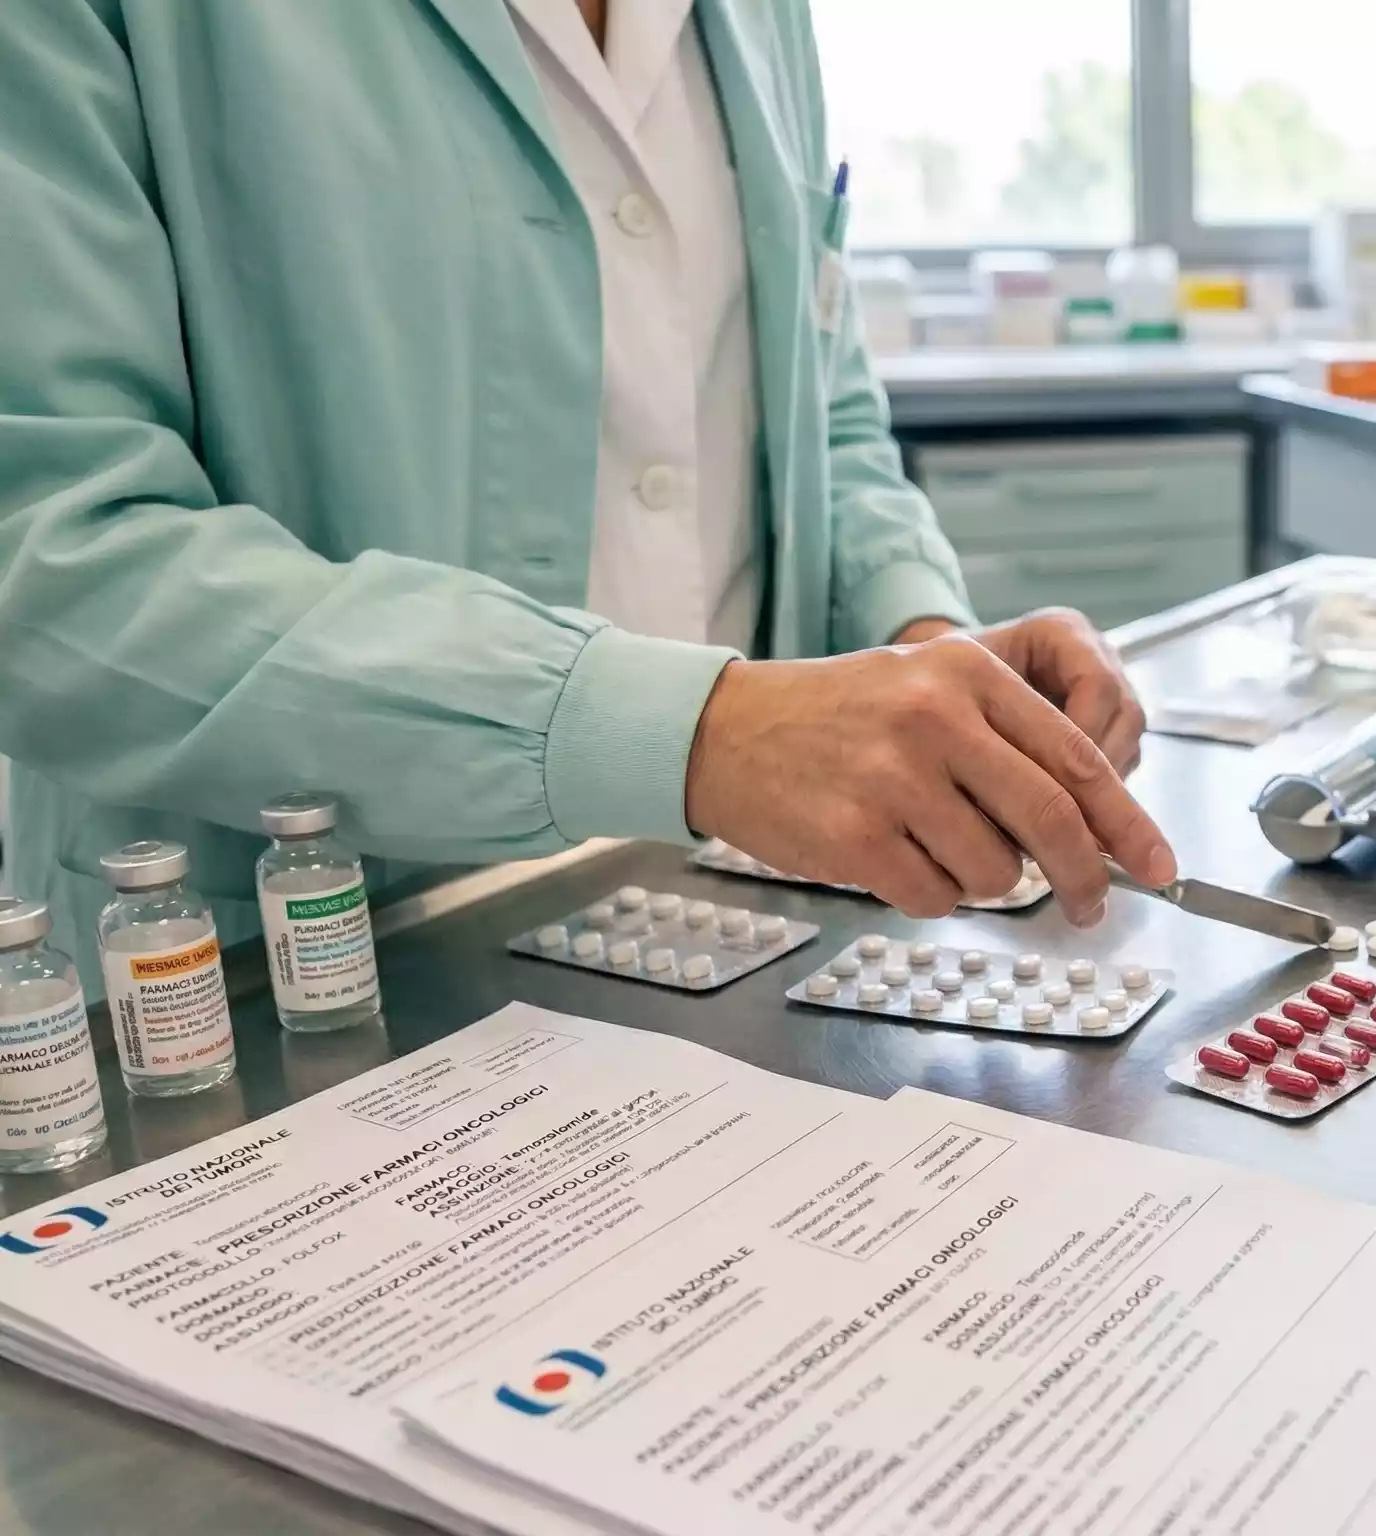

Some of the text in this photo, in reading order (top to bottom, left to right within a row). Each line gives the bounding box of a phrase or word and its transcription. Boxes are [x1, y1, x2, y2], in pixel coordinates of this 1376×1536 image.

[189, 1128, 292, 1175] NAZIONALE
[193, 1153, 263, 1184] TUMORI
[216, 1181, 361, 1254] PRESCRIZIONE
[360, 1140, 443, 1184] FARMACI
[443, 1084, 549, 1142] ONCOLOGICI
[448, 1208, 528, 1255] FARMACI
[528, 1151, 631, 1210] ONCOLOGICI
[864, 1265, 935, 1319] FARMACI
[931, 1195, 1019, 1265] ONCOLOGICI
